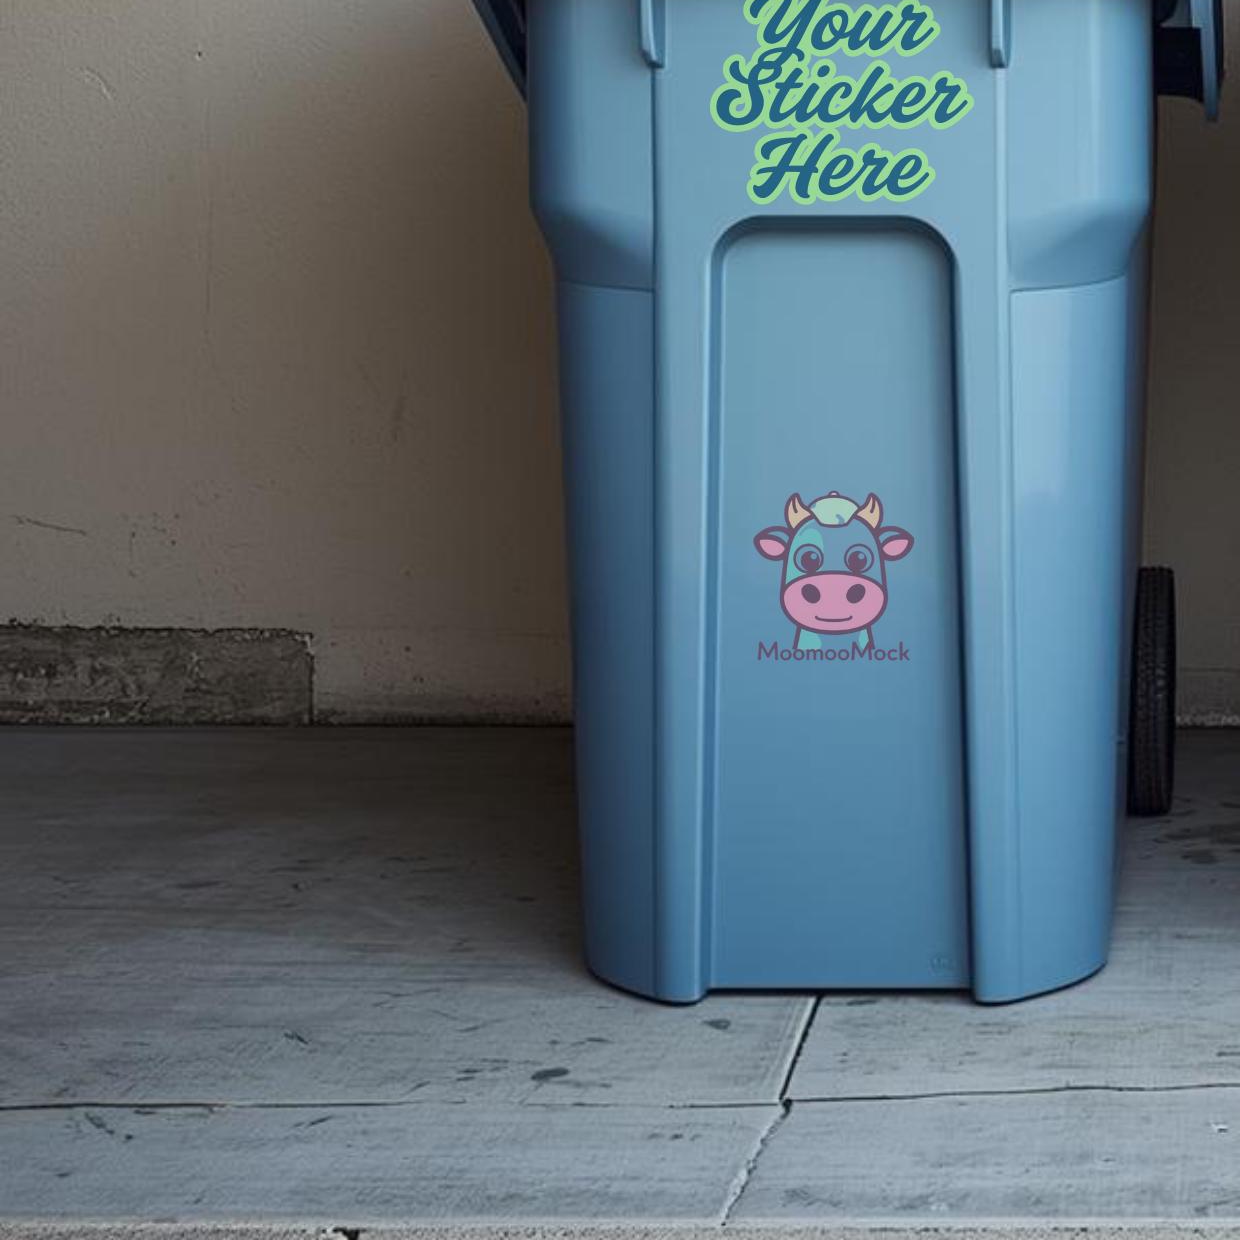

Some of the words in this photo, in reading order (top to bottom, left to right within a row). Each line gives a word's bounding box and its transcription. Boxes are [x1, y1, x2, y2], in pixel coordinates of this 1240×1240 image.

[716, 60, 968, 126] Sticker
[753, 133, 930, 199] Here
[757, 640, 911, 662] MoomooMock
